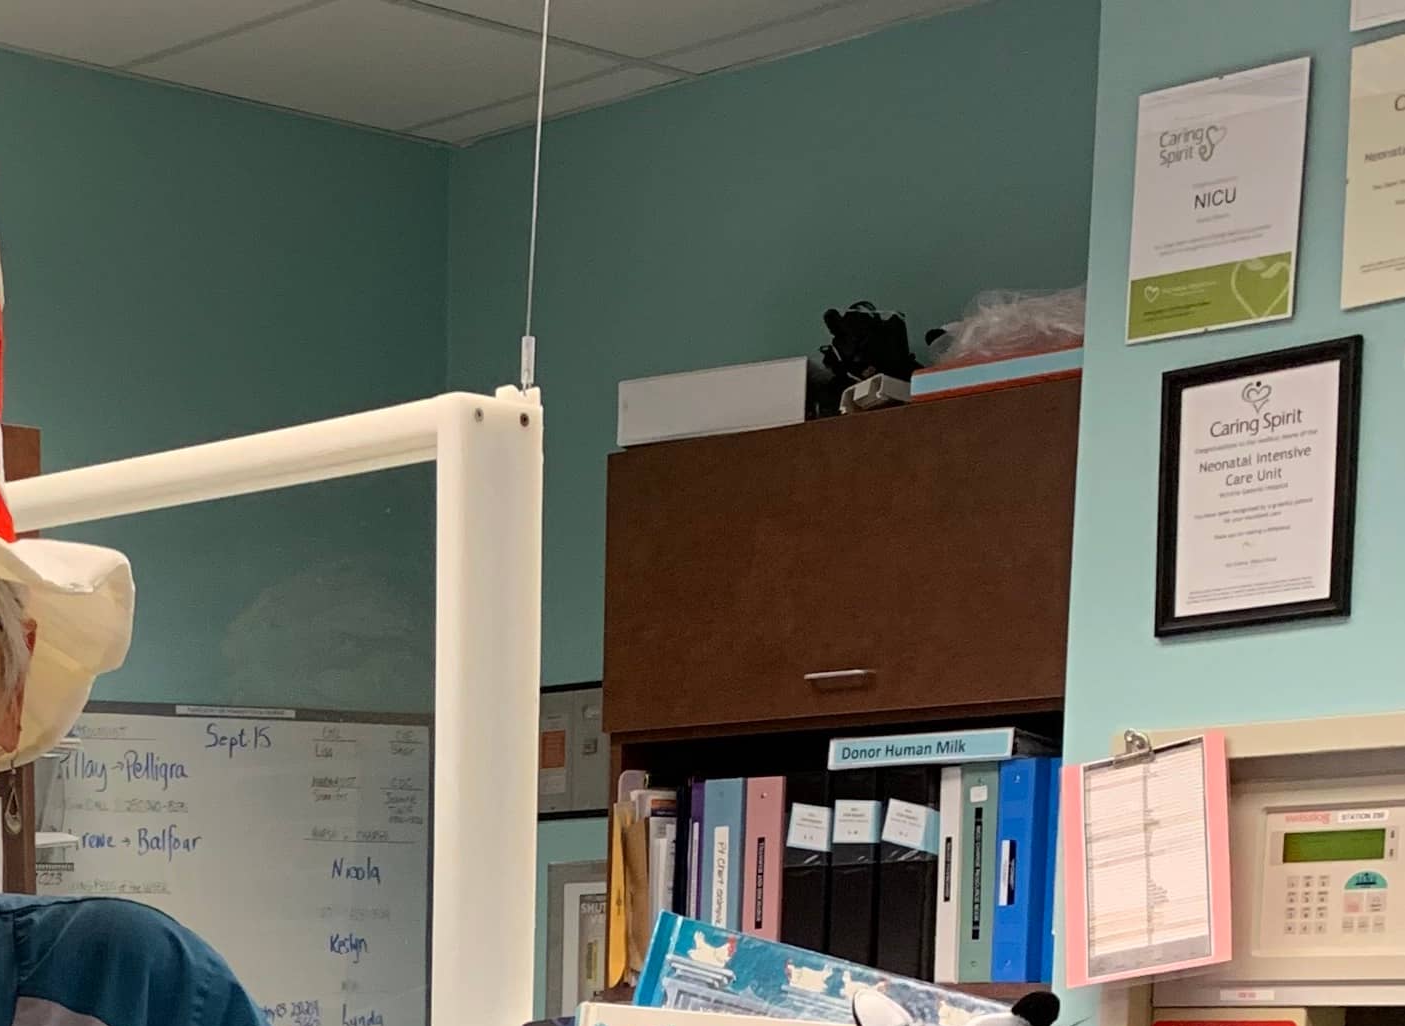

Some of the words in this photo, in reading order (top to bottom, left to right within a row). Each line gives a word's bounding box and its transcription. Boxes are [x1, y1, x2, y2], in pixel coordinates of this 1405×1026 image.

[1159, 128, 1204, 149] Caring
[1159, 146, 1194, 168] Spirit
[1194, 187, 1237, 209] NICU
[1210, 418, 1259, 438] Caring
[1262, 408, 1303, 433] Spirit
[1199, 454, 1252, 473] Neonatal
[1256, 446, 1312, 465] Intensive
[1225, 474, 1253, 487] Care
[1257, 467, 1283, 482] Unit
[842, 744, 881, 761] Donor
[884, 743, 933, 758] Human
[936, 738, 966, 754] Milk
